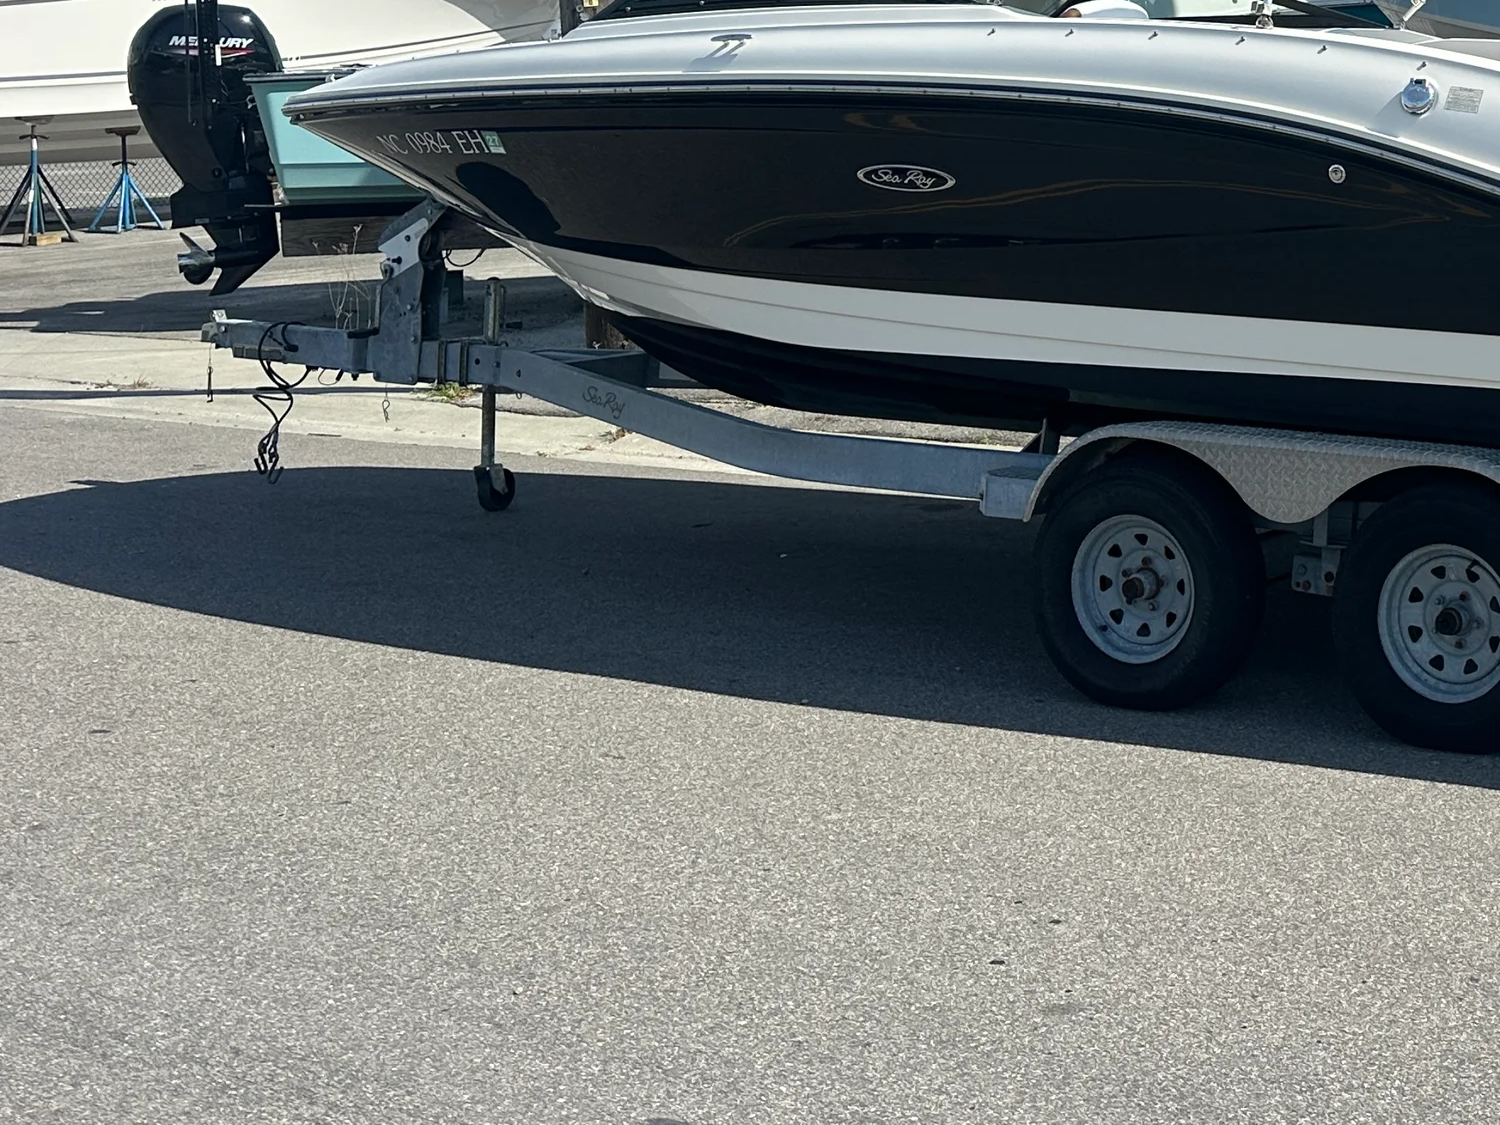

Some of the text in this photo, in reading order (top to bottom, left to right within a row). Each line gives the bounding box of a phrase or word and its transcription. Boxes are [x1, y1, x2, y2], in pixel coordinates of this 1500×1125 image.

[169, 35, 254, 49] MEURY
[376, 129, 490, 155] NC 0984 EH
[485, 135, 499, 147] 27
[871, 169, 937, 189] Sea Ray
[582, 386, 626, 420] Sea Ray
